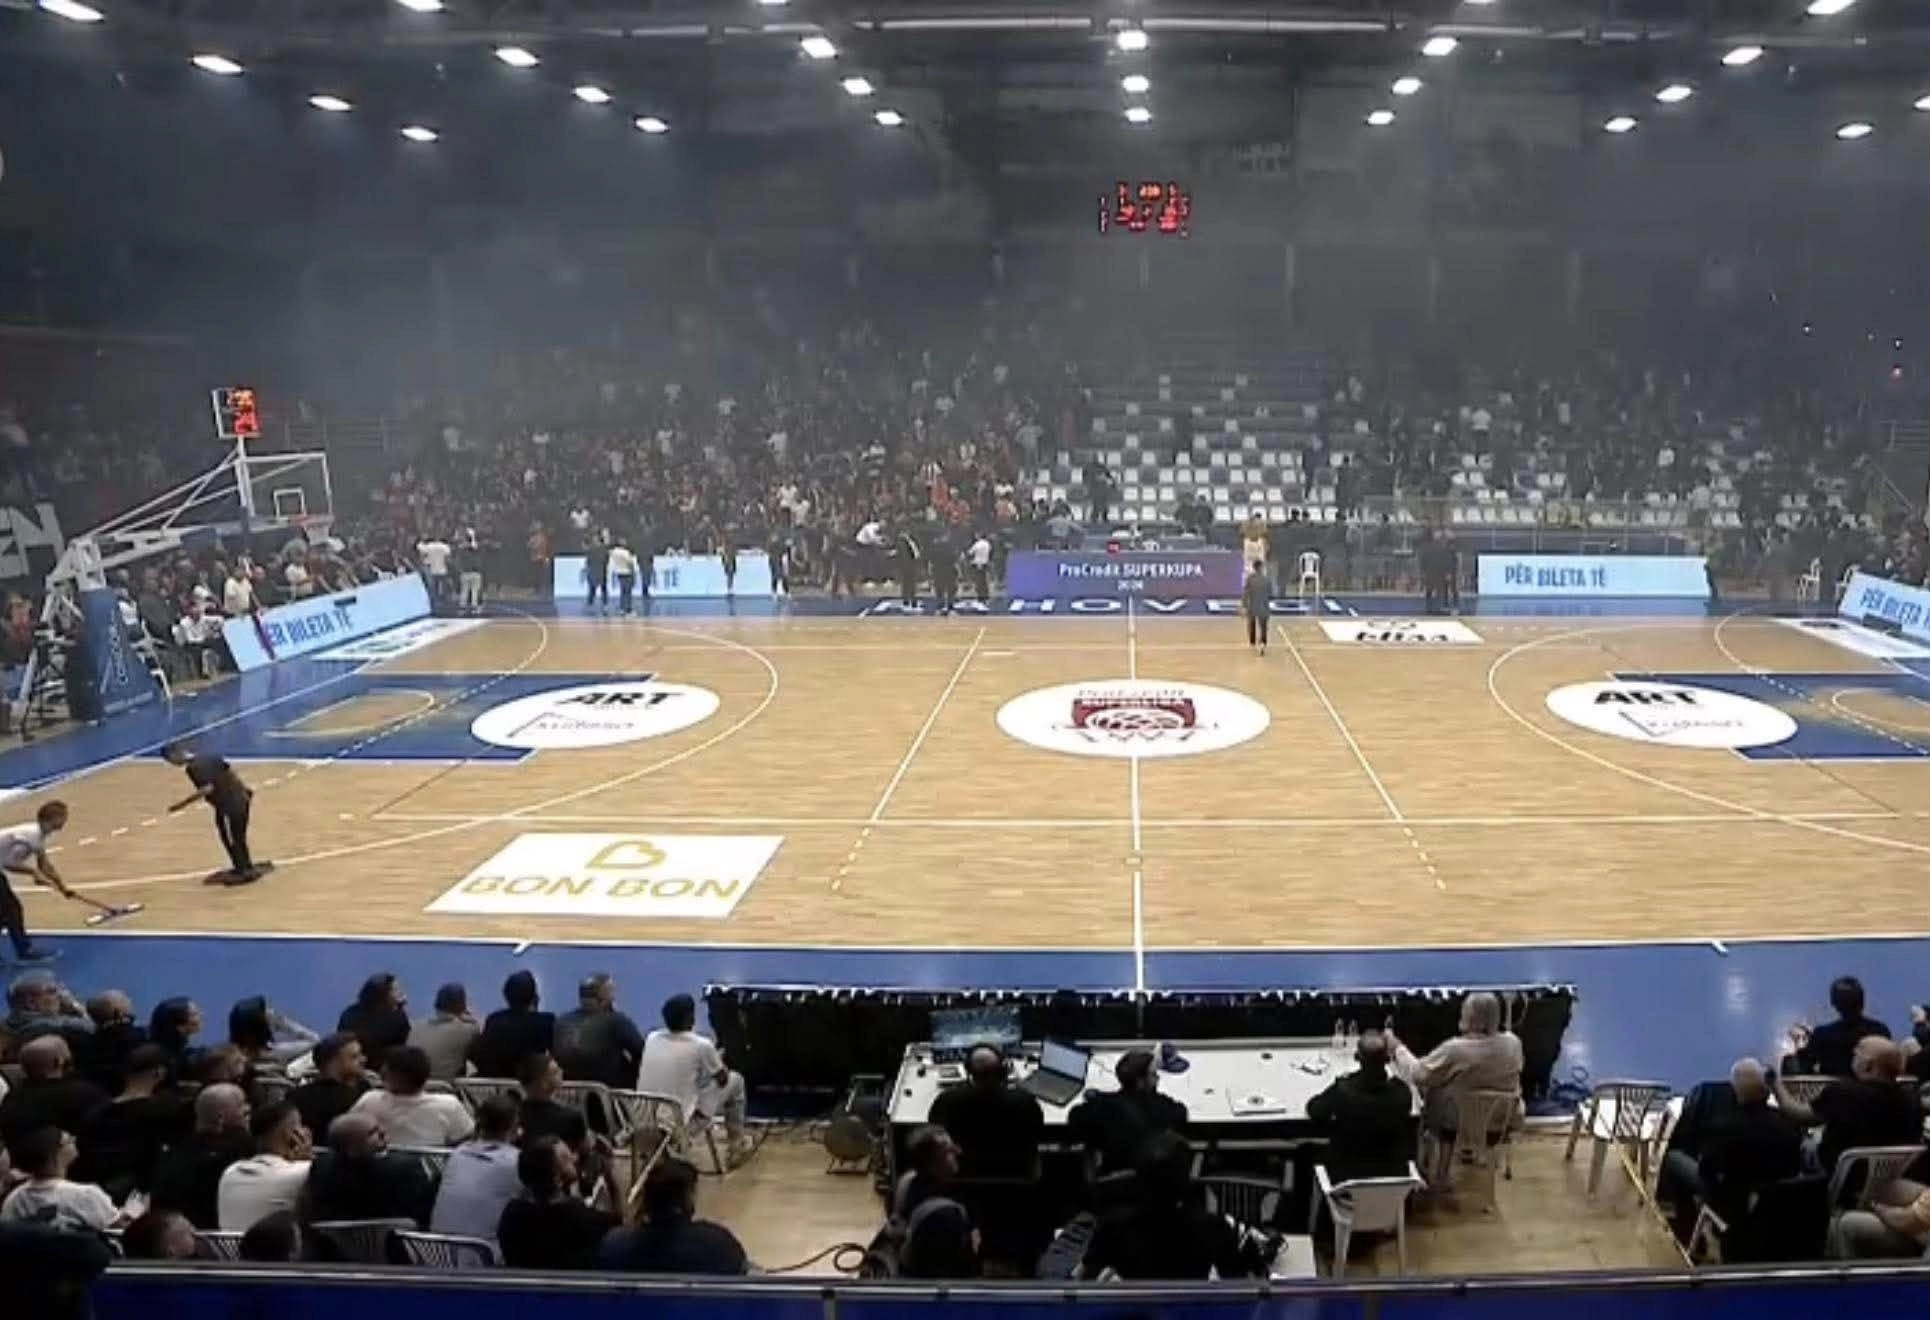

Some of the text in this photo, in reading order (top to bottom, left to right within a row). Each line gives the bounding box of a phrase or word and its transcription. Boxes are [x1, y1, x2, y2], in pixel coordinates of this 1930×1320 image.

[1122, 562, 1204, 577] SUPERKUPA
[1538, 566, 1586, 587] BILETA
[555, 692, 685, 705] ART
[1594, 690, 1697, 704] ART
[461, 876, 740, 898] BON BON
